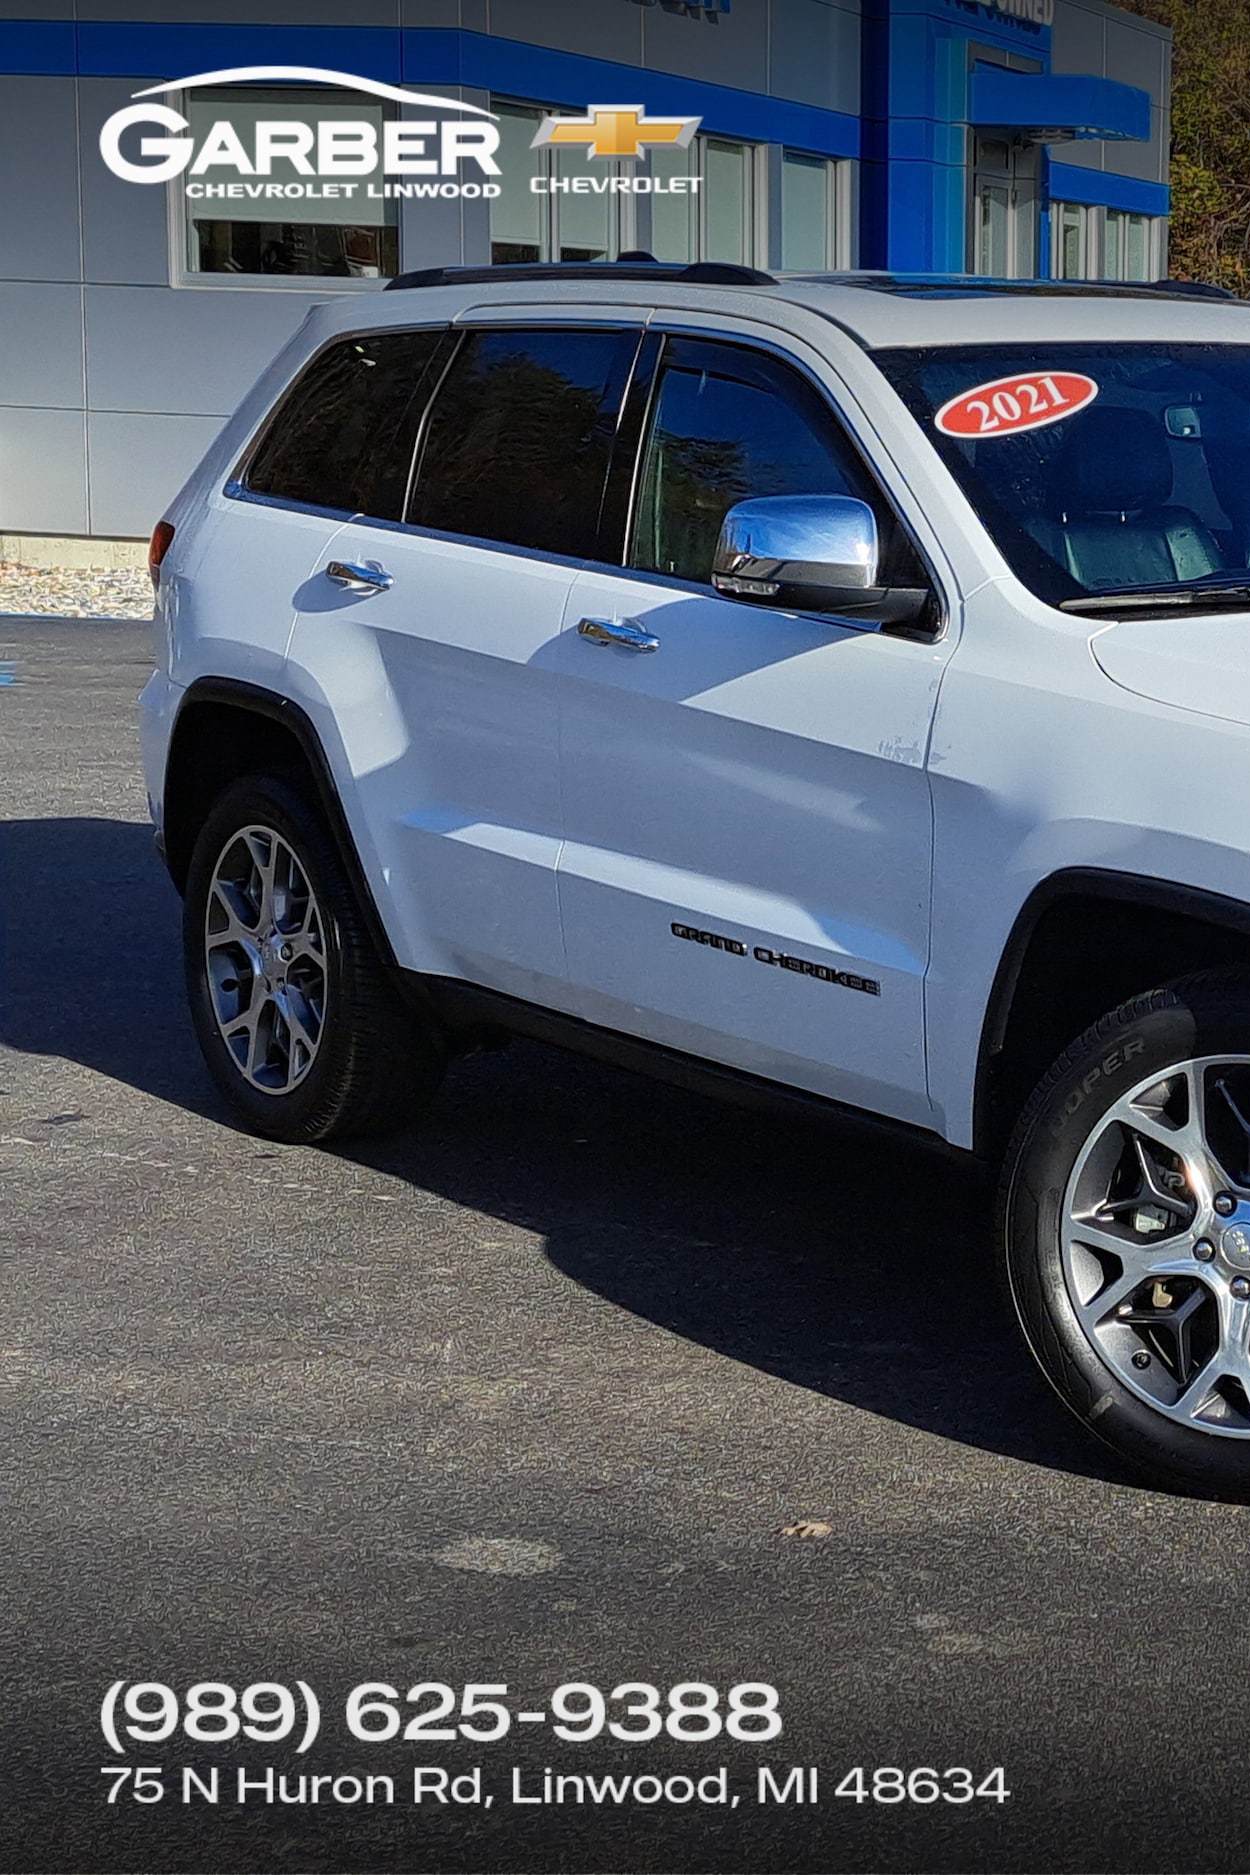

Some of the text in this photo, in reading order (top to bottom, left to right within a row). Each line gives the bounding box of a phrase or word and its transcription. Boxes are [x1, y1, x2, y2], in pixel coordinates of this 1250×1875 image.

[966, 376, 1071, 432] 2021
[670, 921, 882, 998] GRAND CHEROKEE
